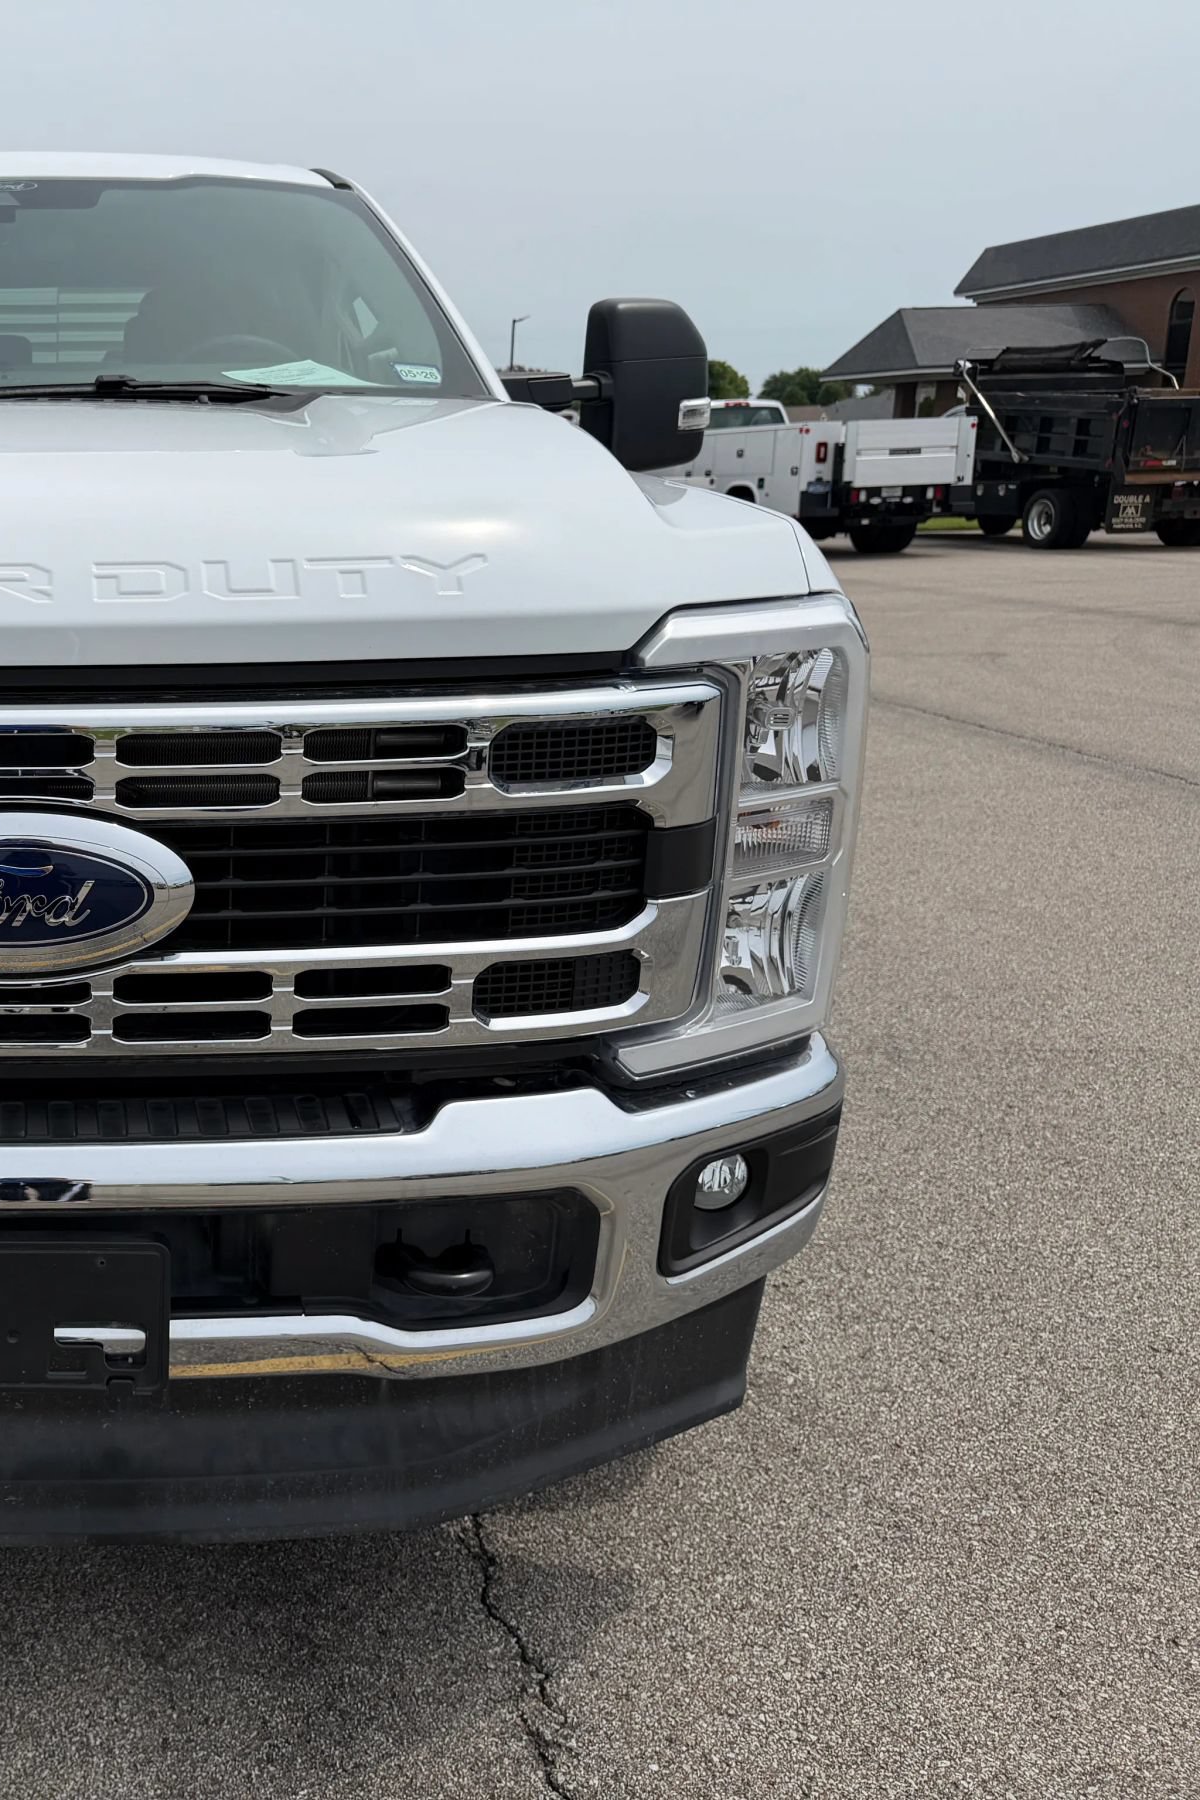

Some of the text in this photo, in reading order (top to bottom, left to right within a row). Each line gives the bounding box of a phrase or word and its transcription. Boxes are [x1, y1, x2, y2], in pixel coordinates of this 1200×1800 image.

[1113, 494, 1151, 504] DOUBLE A
[92, 553, 489, 602] DUTY
